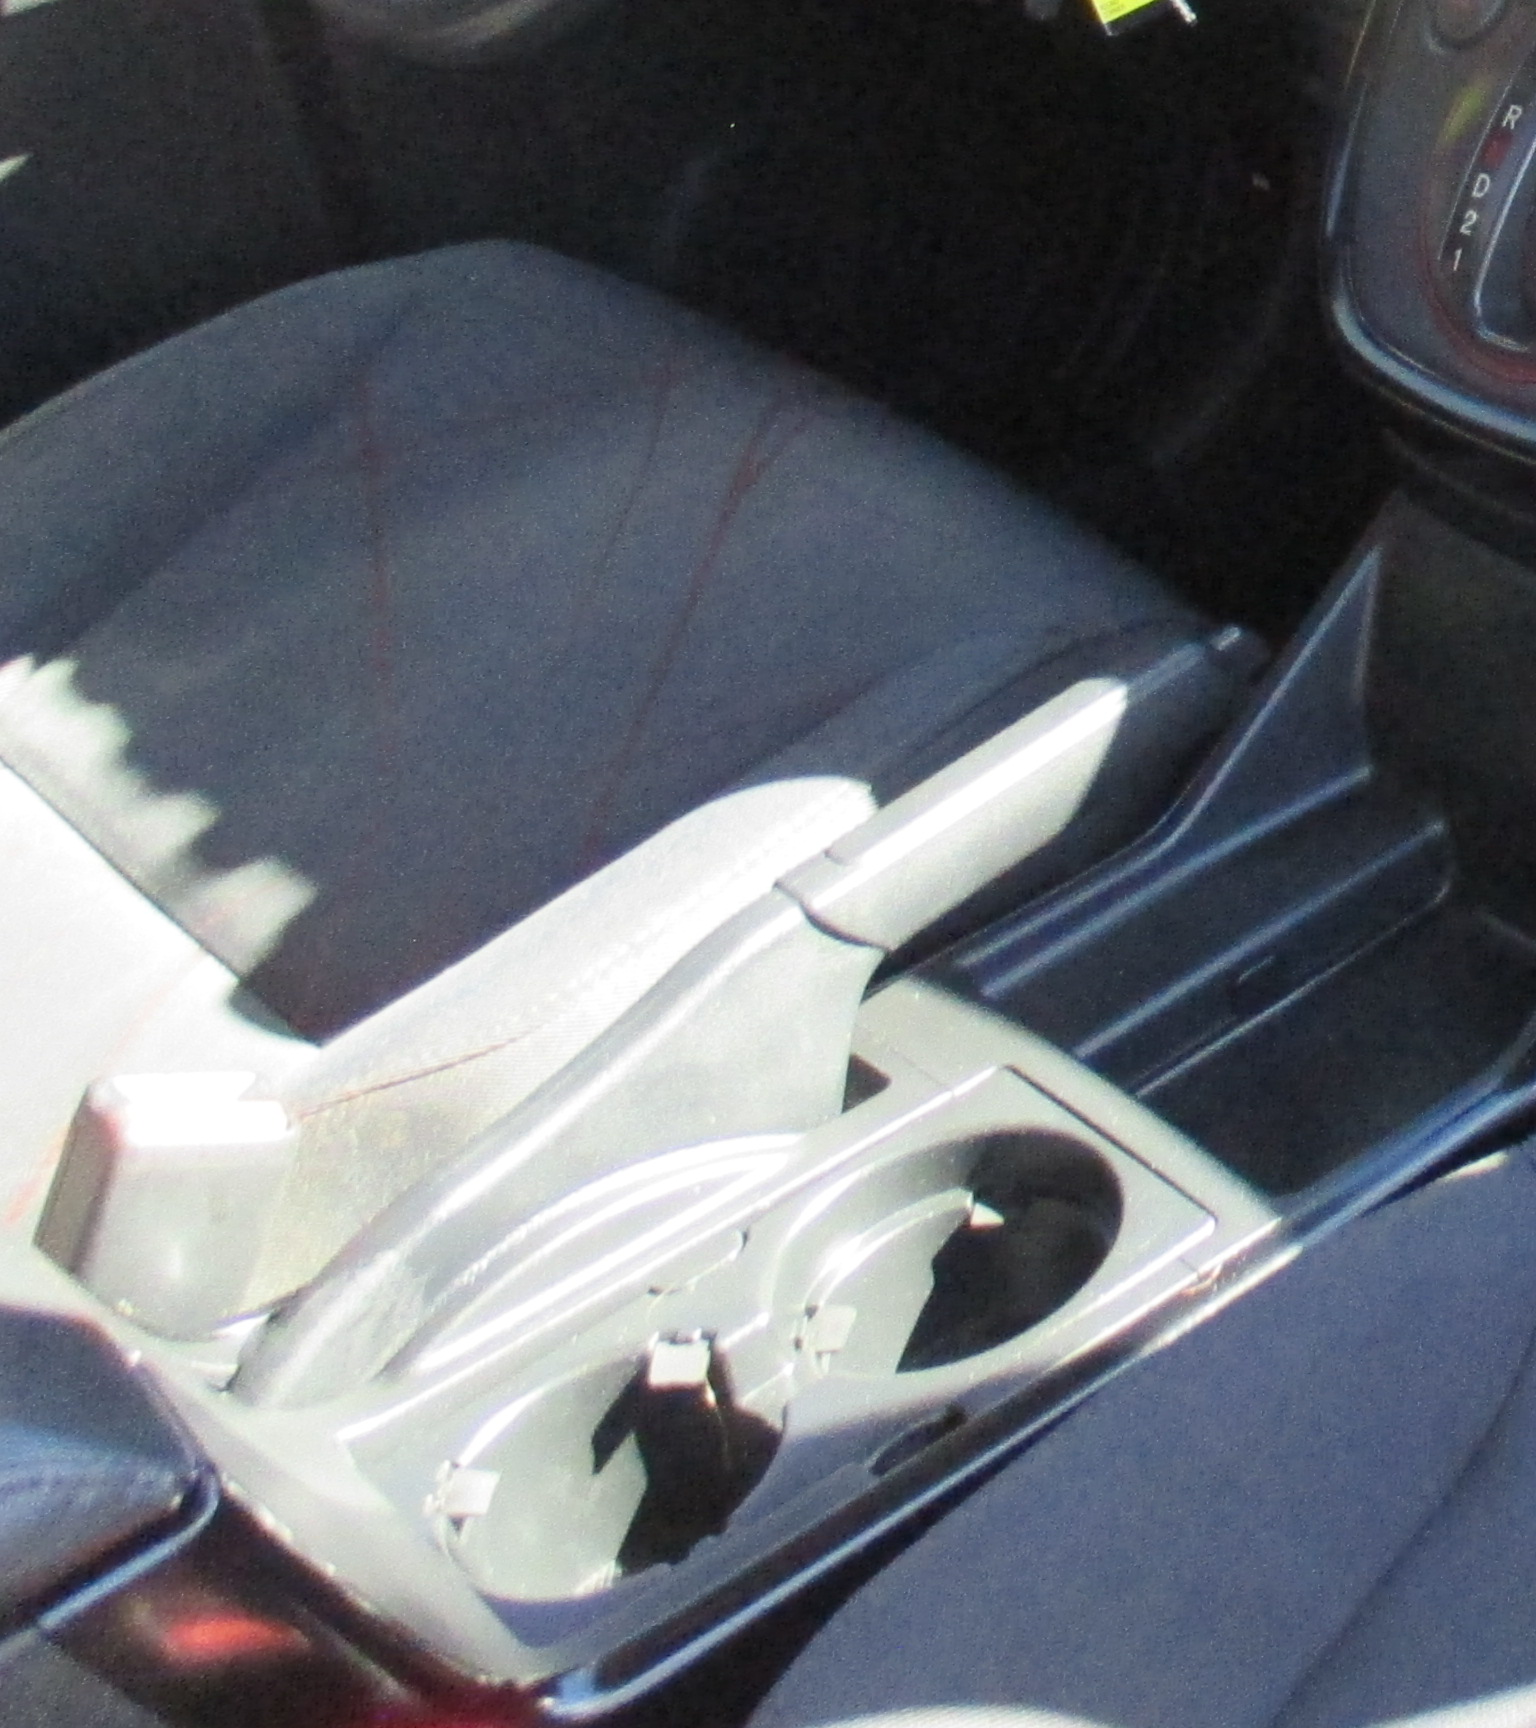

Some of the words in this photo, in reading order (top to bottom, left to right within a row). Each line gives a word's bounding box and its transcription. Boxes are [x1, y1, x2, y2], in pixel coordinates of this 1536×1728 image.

[1502, 104, 1523, 129] R
[1471, 173, 1491, 198] D
[1459, 209, 1479, 236] 2
[1453, 248, 1463, 271] 1
